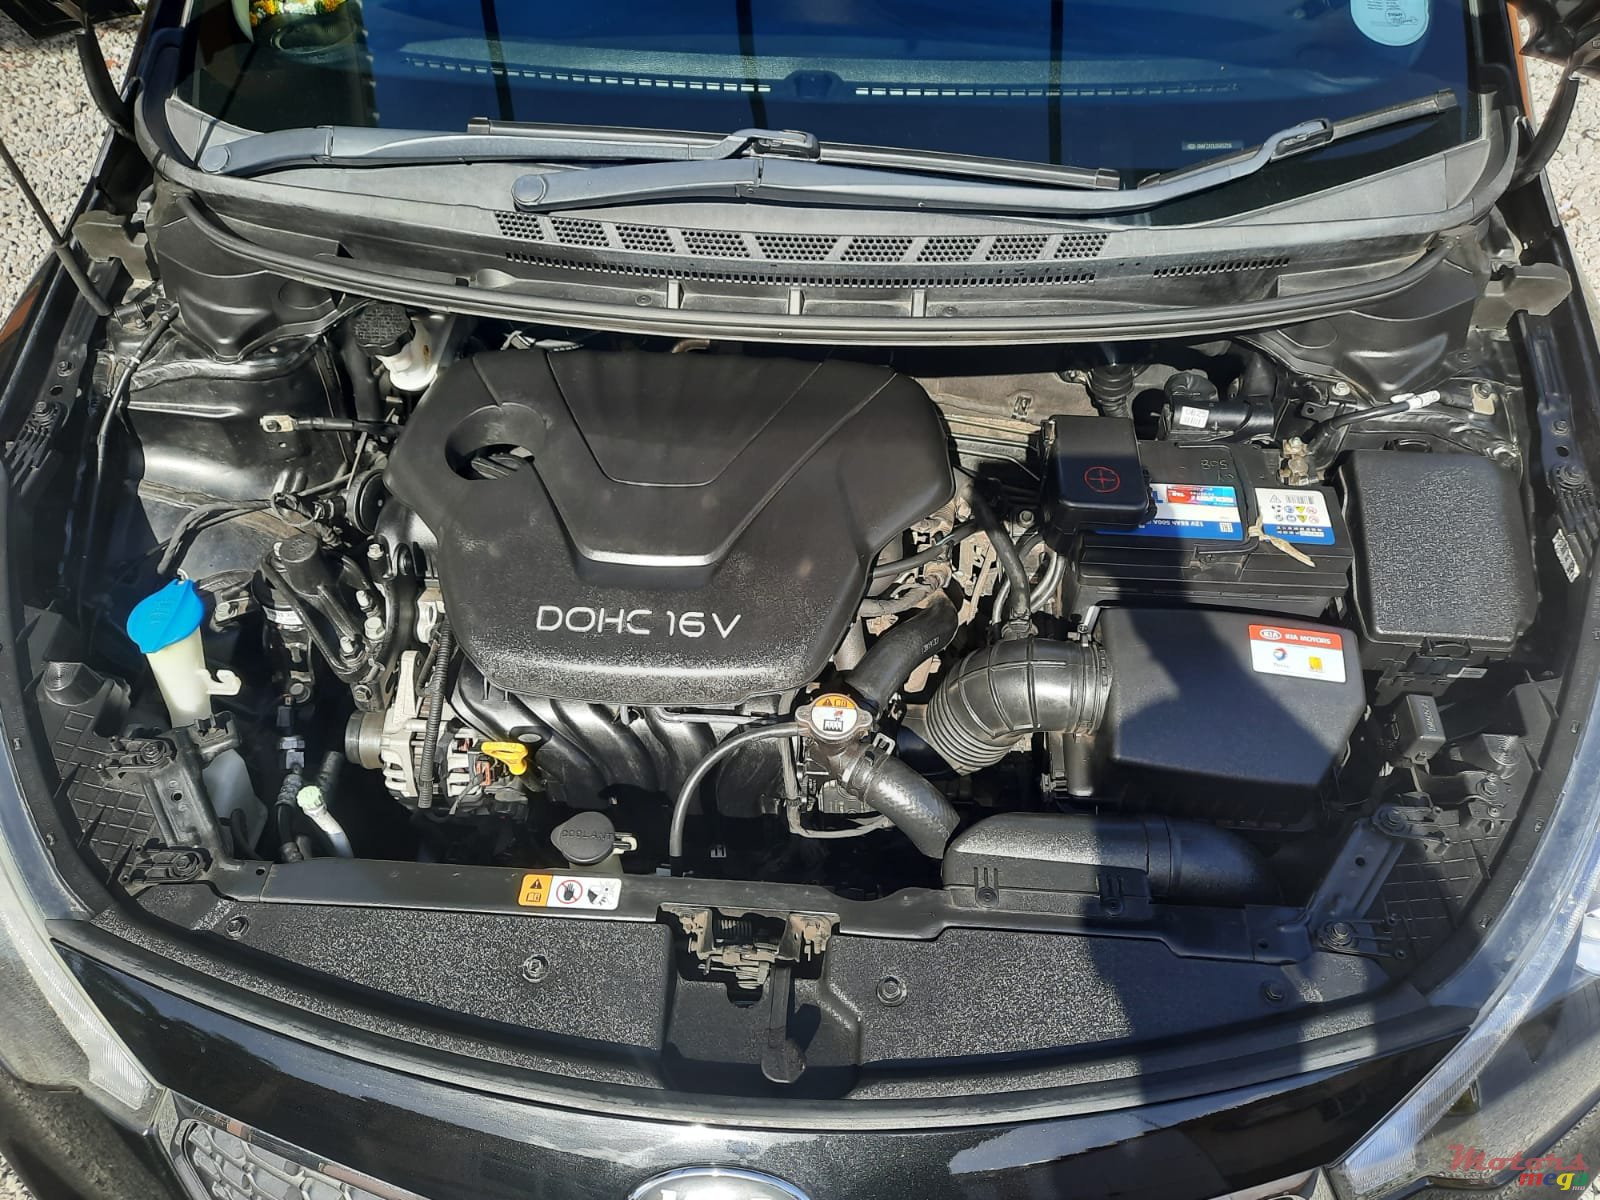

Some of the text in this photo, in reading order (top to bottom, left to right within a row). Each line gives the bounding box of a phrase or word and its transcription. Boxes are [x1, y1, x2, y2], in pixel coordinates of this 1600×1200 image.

[536, 605, 653, 635] DOHC
[1300, 635, 1331, 645] MOTORS
[561, 829, 614, 841] COOLANT
